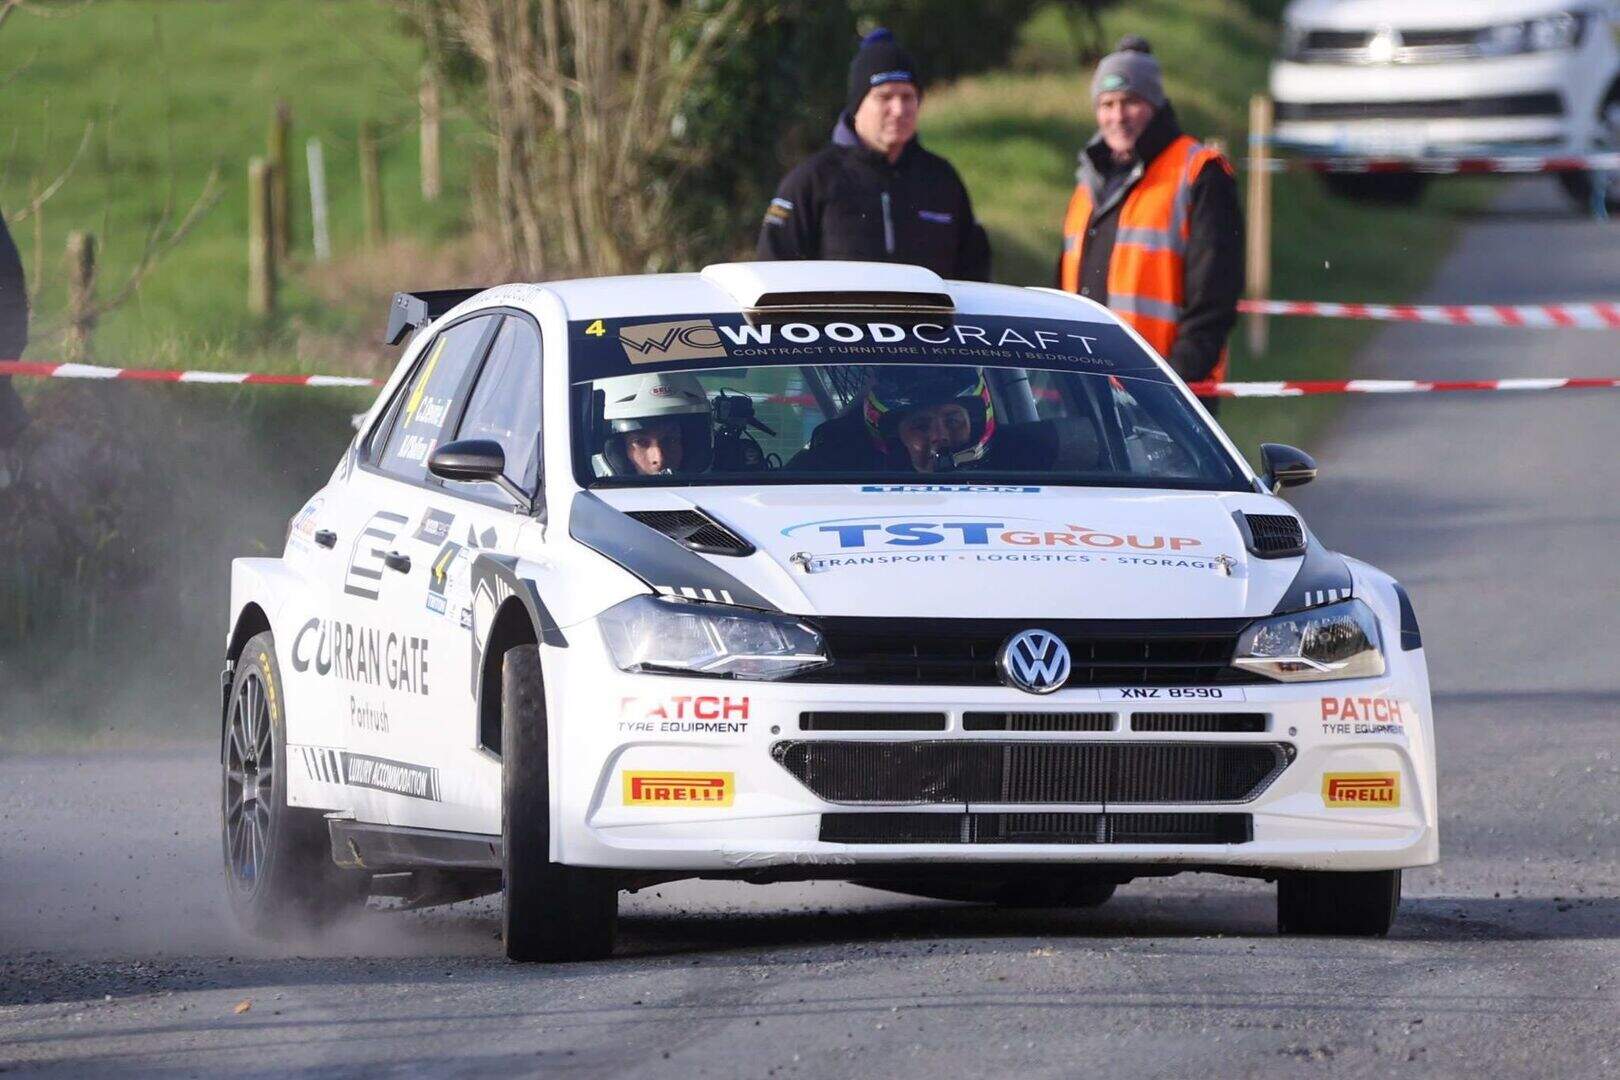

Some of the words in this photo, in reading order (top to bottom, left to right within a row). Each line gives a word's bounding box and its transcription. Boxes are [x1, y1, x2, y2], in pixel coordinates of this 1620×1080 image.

[584, 320, 607, 337] 4
[732, 346, 824, 356] CONTRACT
[828, 346, 919, 356] FURNITURE
[932, 347, 1012, 358] KITCHENS
[1025, 353, 1115, 367] BEDROOMS
[818, 522, 1005, 549] TST
[1000, 529, 1202, 550] GROUP
[815, 554, 950, 568] TRANSPORT
[976, 554, 1091, 563] LOGISTICS
[1117, 556, 1218, 570] STORAGE
[291, 616, 381, 686] CURRAN
[386, 631, 429, 695] GATE
[1119, 688, 1162, 698] XNZ
[1168, 687, 1223, 698] 8590
[350, 694, 390, 733] Portrush
[1321, 697, 1404, 723] PATCH
[618, 722, 655, 733] TYRE
[660, 721, 749, 733] EQUIPMENT
[1322, 723, 1352, 735] TYRE
[631, 777, 725, 801] PIRELLI
[1328, 778, 1395, 801] PIRELLI
